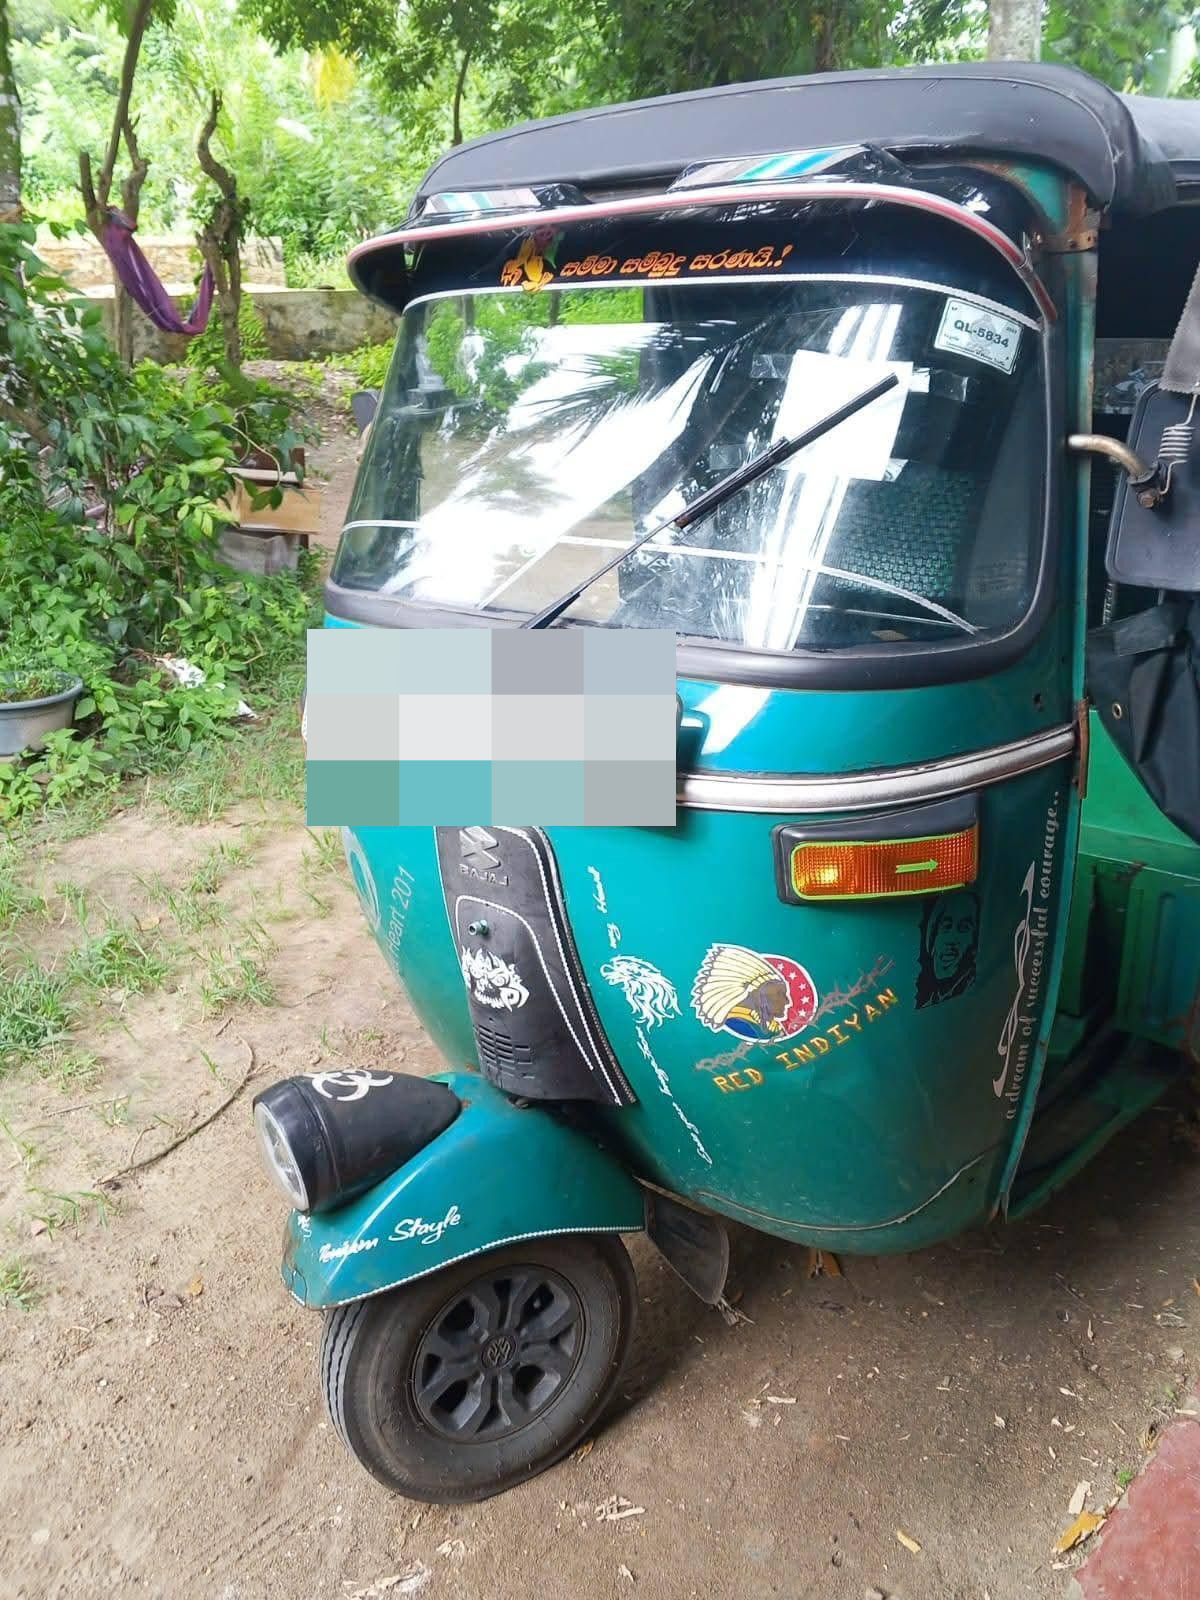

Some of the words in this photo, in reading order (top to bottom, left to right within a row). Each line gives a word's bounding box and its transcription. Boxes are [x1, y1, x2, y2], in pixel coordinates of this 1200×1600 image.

[954, 319, 1010, 349] QL-5834
[1026, 906, 1049, 1008] successful
[713, 1067, 765, 1094] RED
[775, 987, 900, 1071] INDIYAN
[1018, 1015, 1037, 1036] of
[1005, 1044, 1029, 1102] dream
[388, 1205, 462, 1246] Stayle
